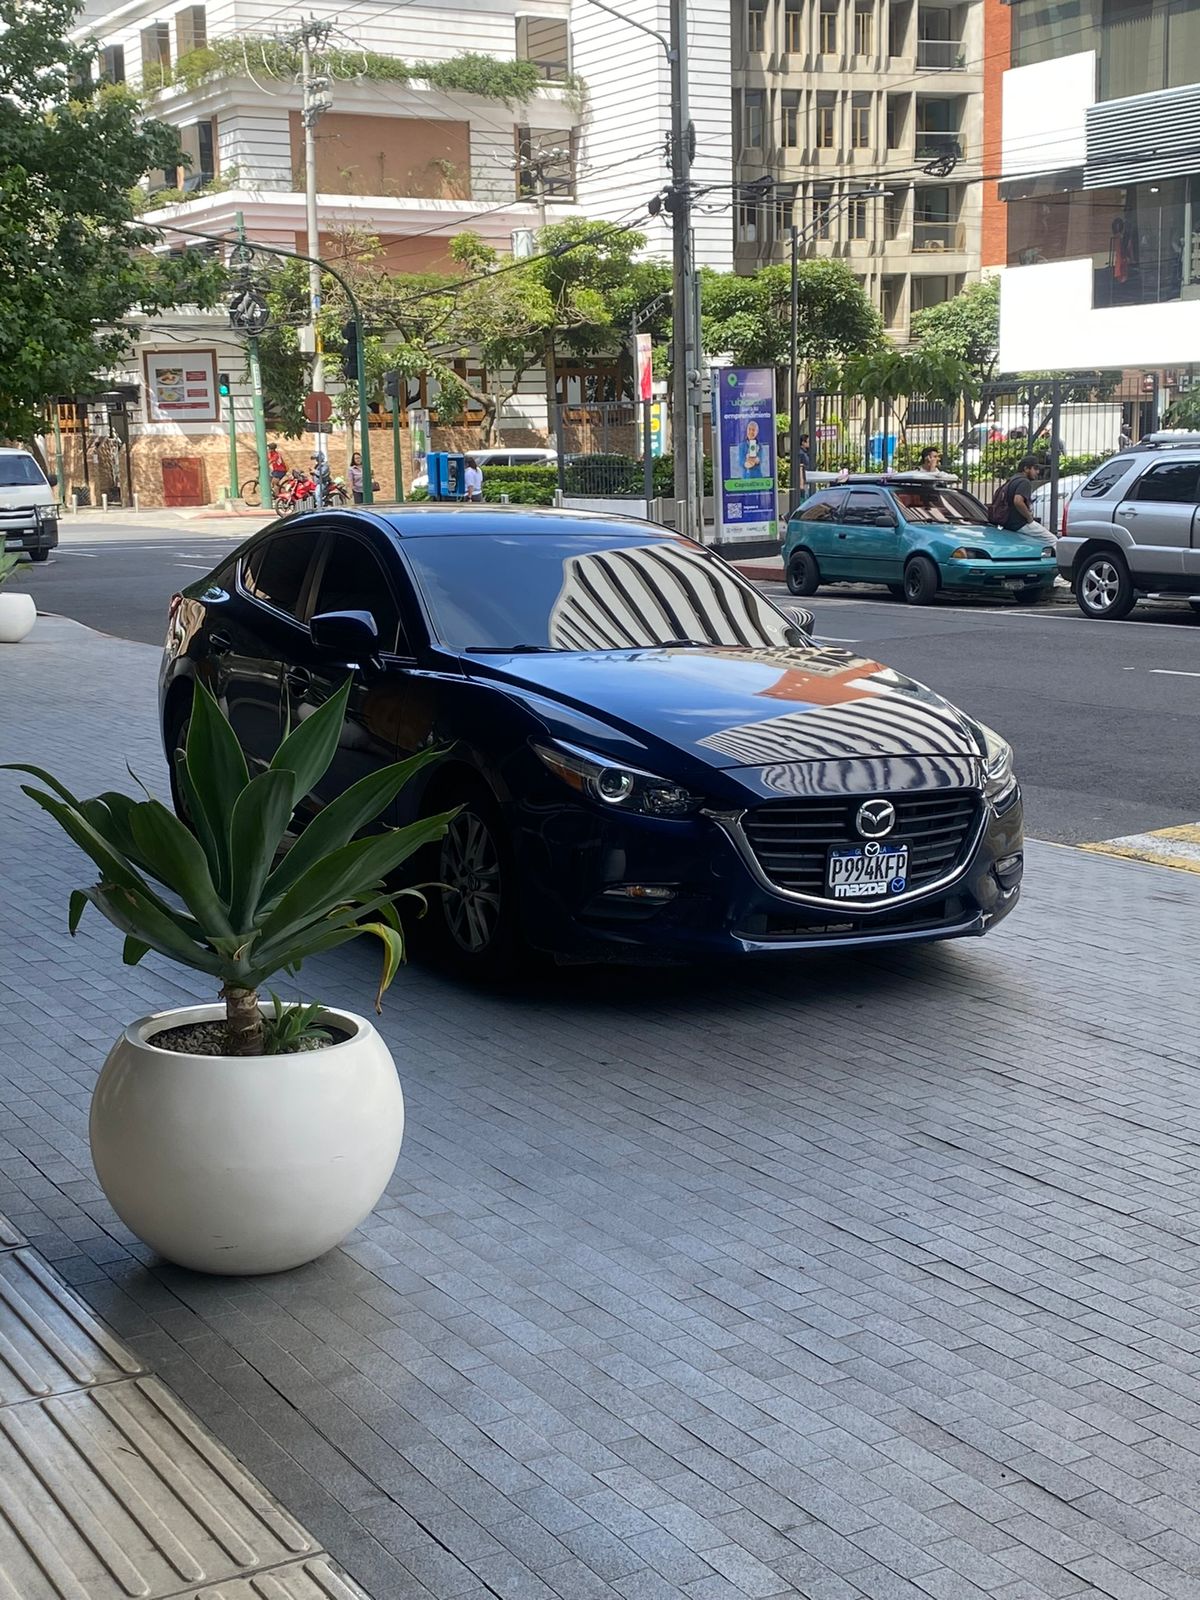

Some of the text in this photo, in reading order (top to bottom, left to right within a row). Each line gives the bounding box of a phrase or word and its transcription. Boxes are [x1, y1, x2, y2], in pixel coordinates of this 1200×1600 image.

[723, 412, 771, 421] emprendimiento
[831, 853, 906, 883] P994KFP
[834, 882, 887, 897] mazda
